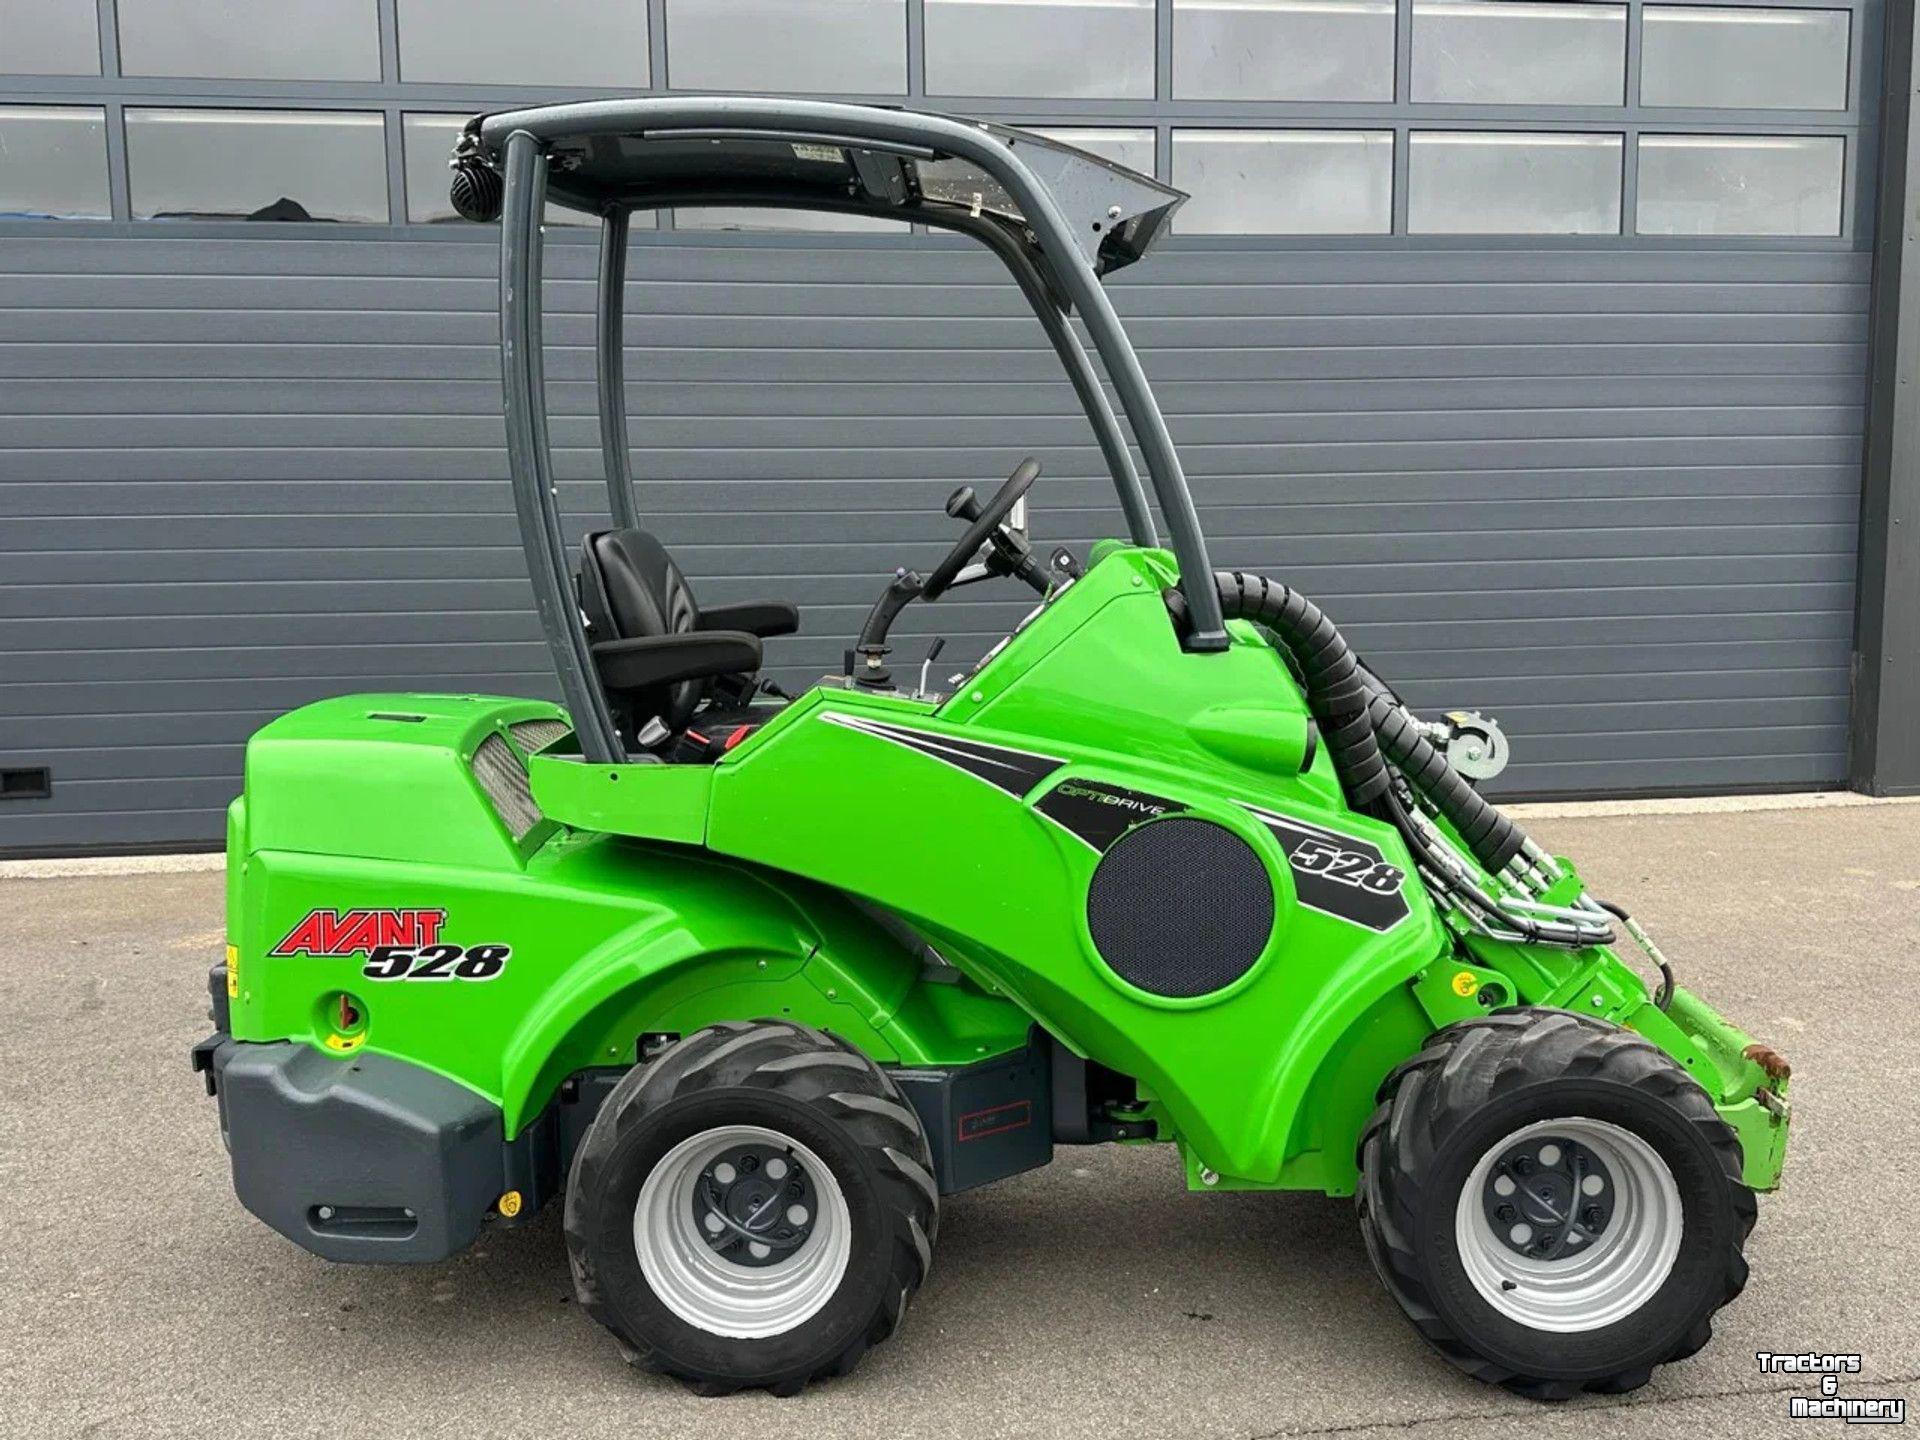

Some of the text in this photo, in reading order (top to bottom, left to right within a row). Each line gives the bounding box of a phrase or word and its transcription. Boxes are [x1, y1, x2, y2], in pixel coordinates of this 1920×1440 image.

[1057, 783, 1166, 815] OPTIDRIVE
[1288, 838, 1406, 895] 528
[267, 908, 447, 957] AVANT
[362, 944, 512, 982] 528
